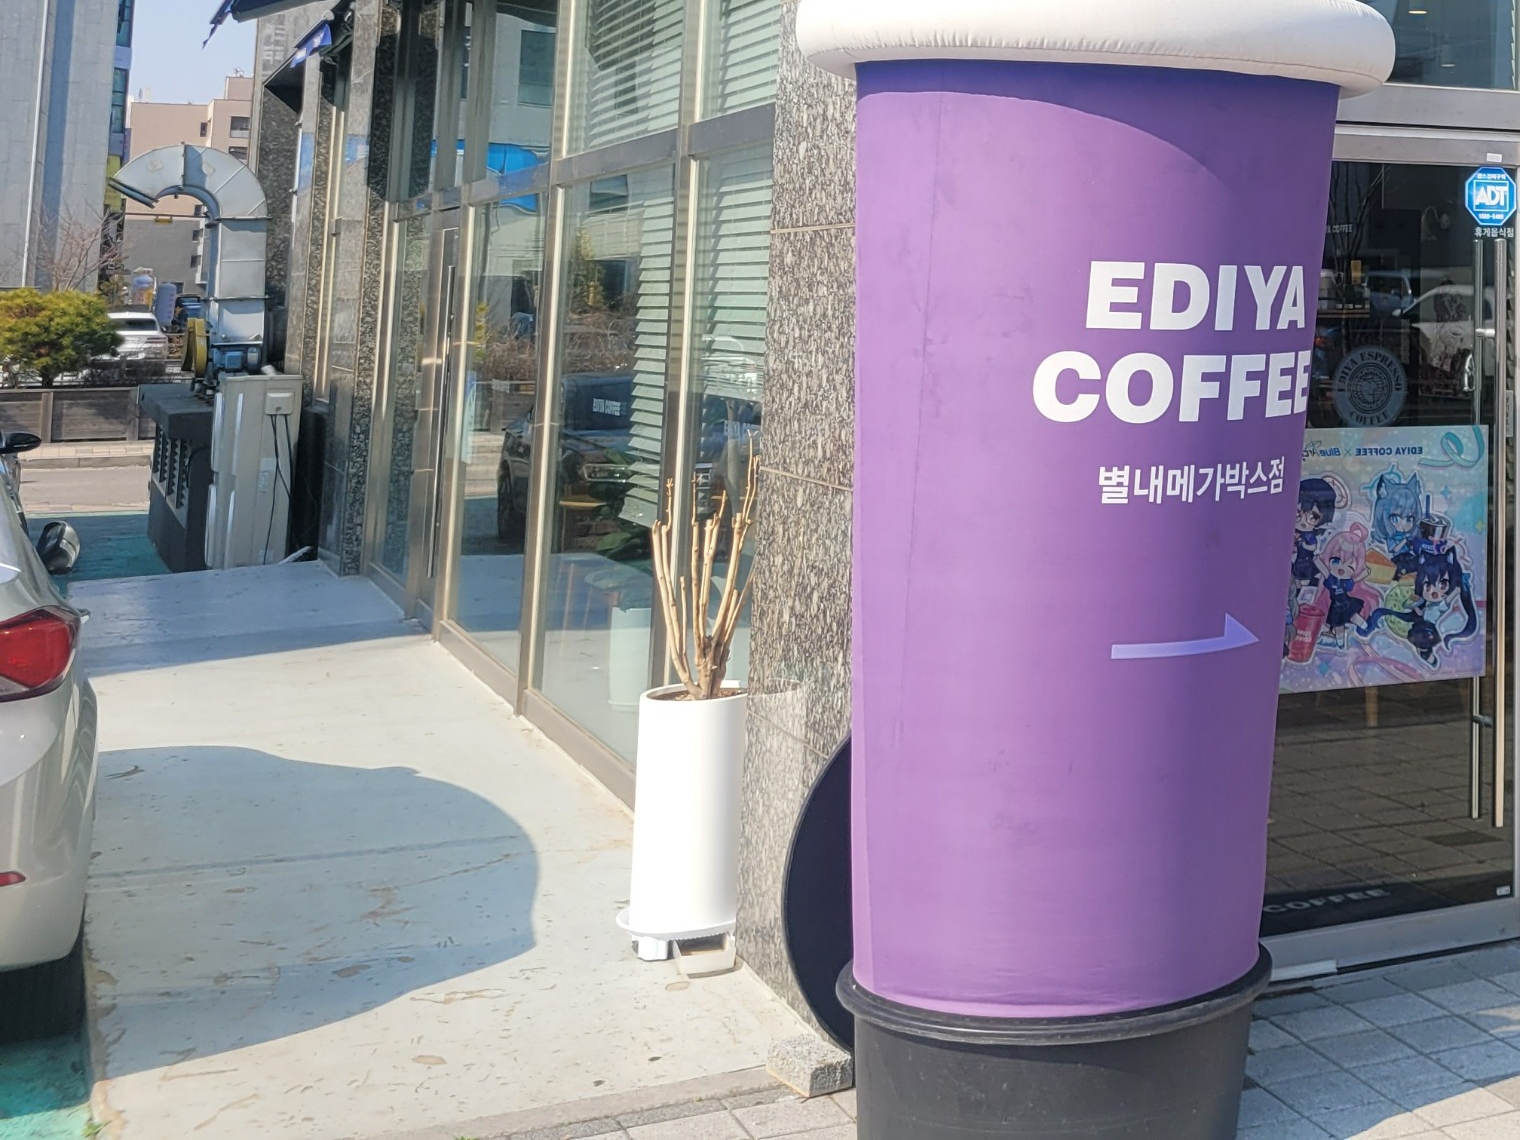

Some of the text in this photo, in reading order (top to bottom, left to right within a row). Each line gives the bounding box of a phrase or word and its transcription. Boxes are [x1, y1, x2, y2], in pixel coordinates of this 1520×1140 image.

[1474, 185, 1508, 207] ADT
[1474, 227, 1515, 238] 휴게음식점
[1084, 260, 1307, 332] EDIYA
[1032, 348, 1312, 425] COFFEE
[1098, 455, 1286, 505] 별내메가박스점
[1263, 888, 1391, 913] COFFEE
